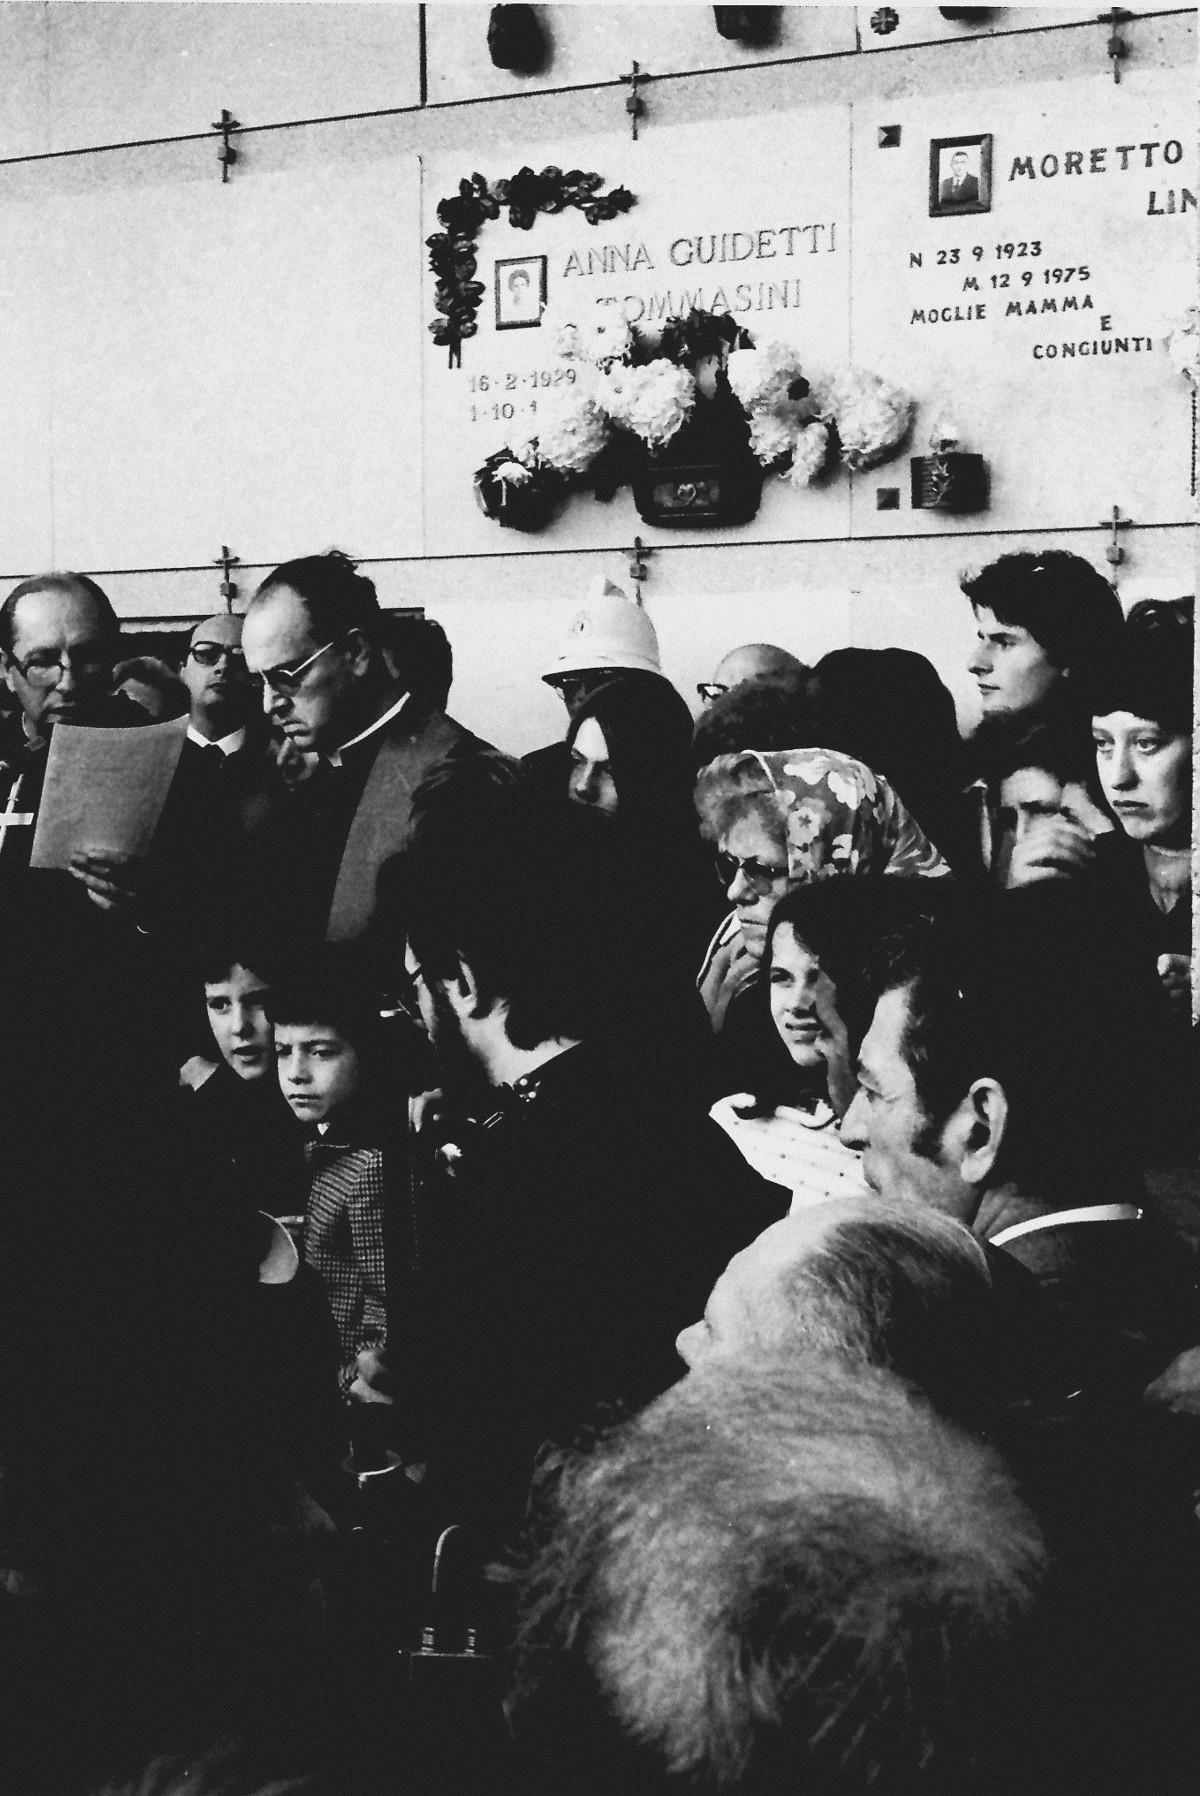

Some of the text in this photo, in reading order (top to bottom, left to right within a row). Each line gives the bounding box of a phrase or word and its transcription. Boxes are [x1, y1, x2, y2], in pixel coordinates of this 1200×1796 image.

[1008, 140, 1183, 181] MORETTO
[563, 223, 837, 277] ANNA GUIDETTI
[910, 240, 1043, 268] N 23 9 1923
[990, 273, 1010, 289] 12
[1021, 271, 1033, 287] 9
[1044, 266, 1090, 285] 1975
[910, 294, 1094, 325] MOGLIE MAMMA
[1100, 314, 1112, 331] E
[1032, 337, 1153, 360] CONGIUNTI
